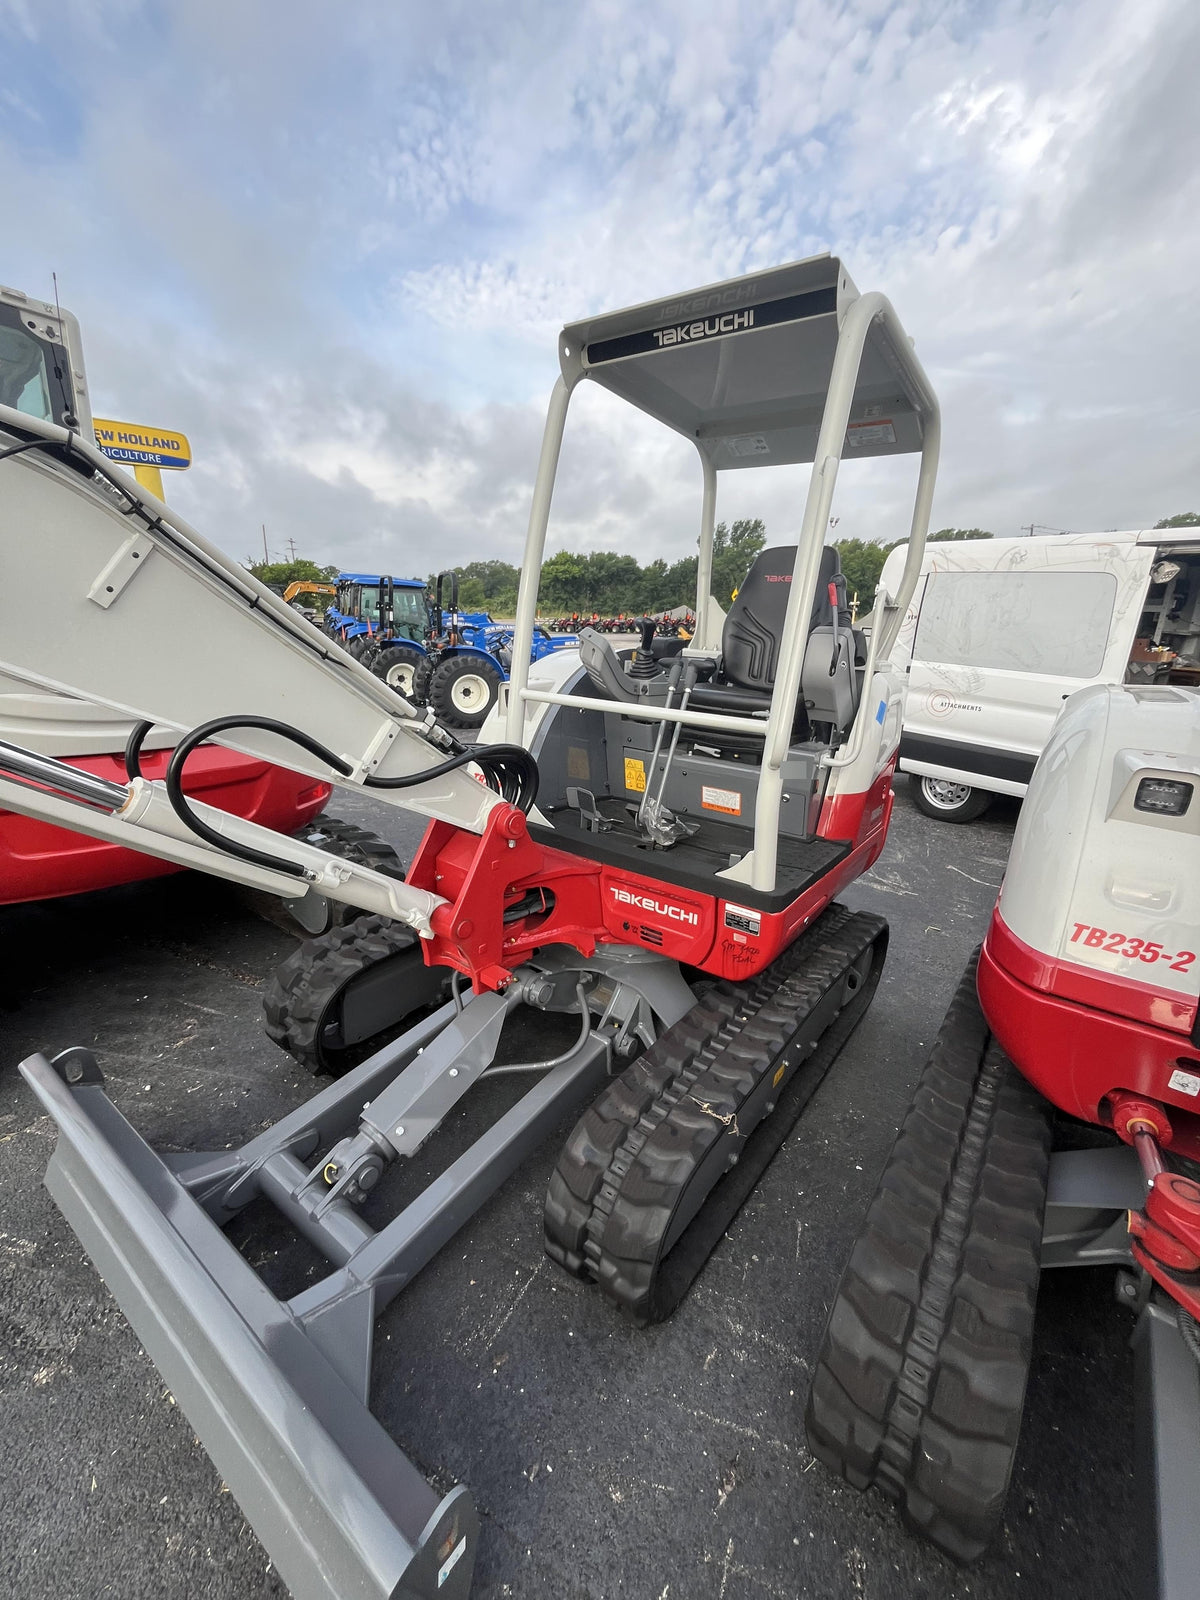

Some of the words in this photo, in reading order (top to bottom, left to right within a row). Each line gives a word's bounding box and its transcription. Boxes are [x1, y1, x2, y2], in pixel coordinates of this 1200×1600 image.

[653, 310, 754, 346] TAKEUCHI
[94, 429, 114, 441] EW
[117, 432, 180, 450] HOLLAND
[101, 447, 161, 463] RICULTURE
[764, 575, 792, 583] TAKE
[940, 702, 982, 712] ATTACHMENTS
[610, 887, 698, 926] TAKEUCHI
[1070, 922, 1196, 973] TB235-2
